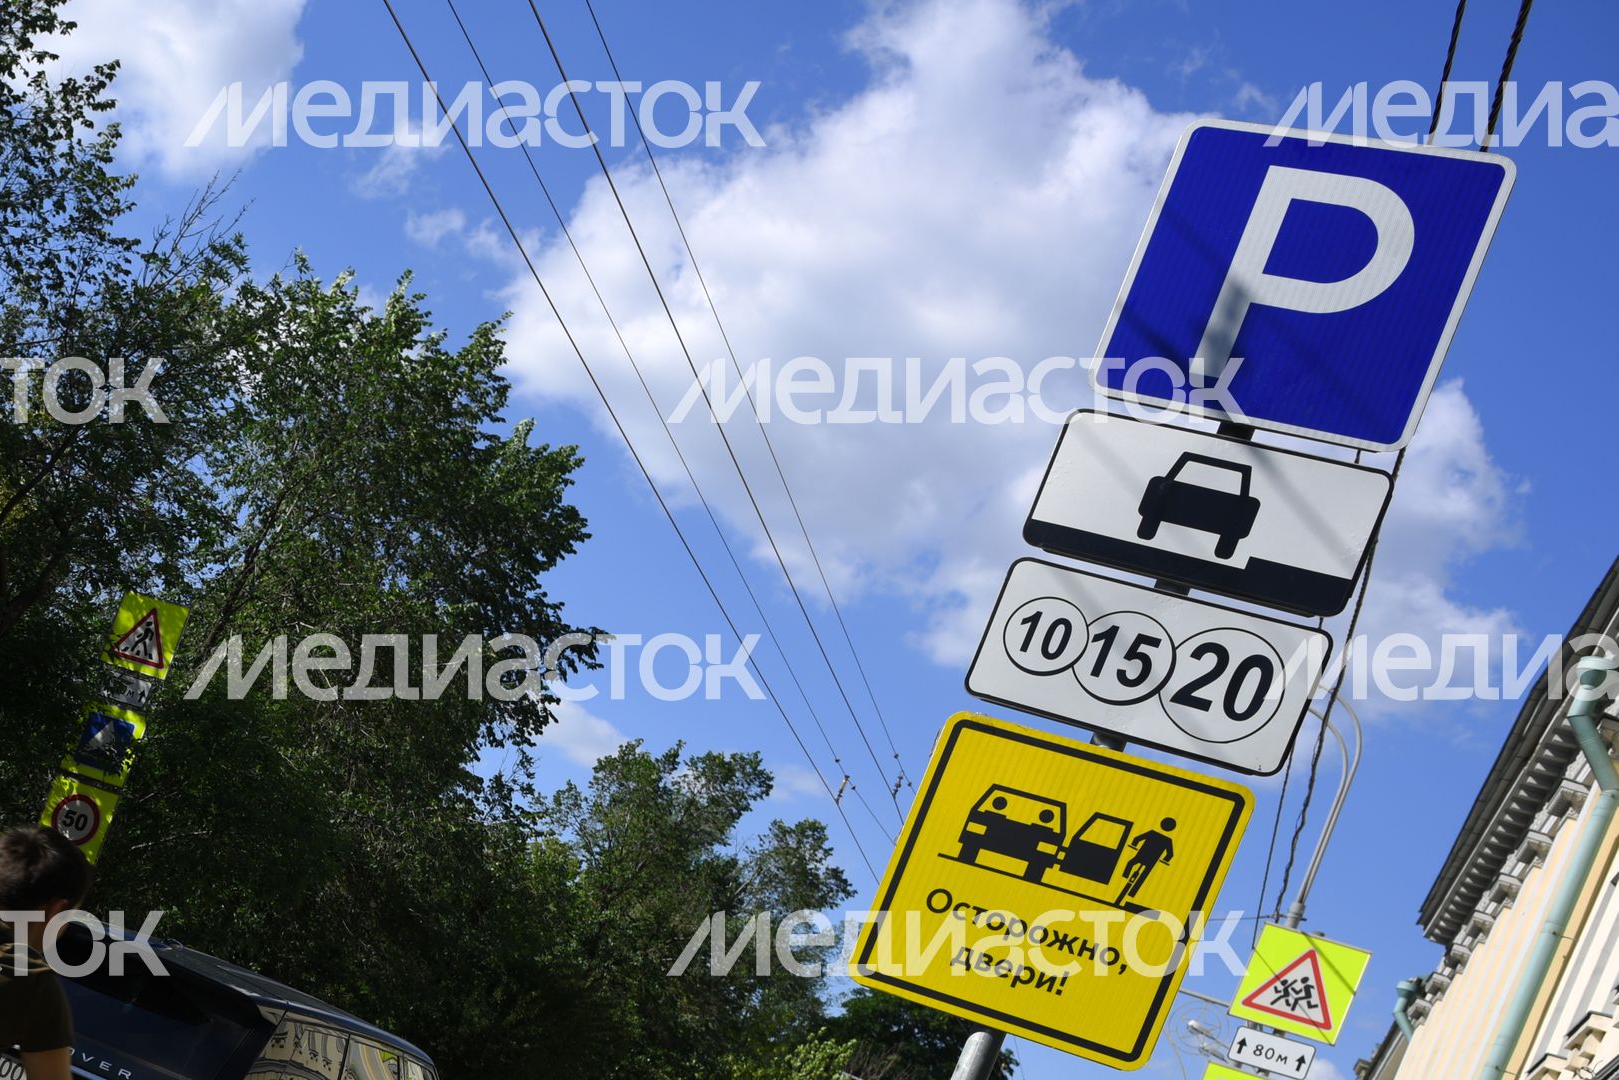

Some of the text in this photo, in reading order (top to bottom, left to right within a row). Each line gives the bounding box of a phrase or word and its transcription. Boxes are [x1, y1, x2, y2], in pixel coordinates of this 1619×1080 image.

[1189, 165, 1415, 378] P
[1019, 610, 1274, 721] 10 15 20
[62, 809, 88, 832] 50
[926, 888, 1128, 975] Осторожно,
[950, 947, 1070, 996] двери!
